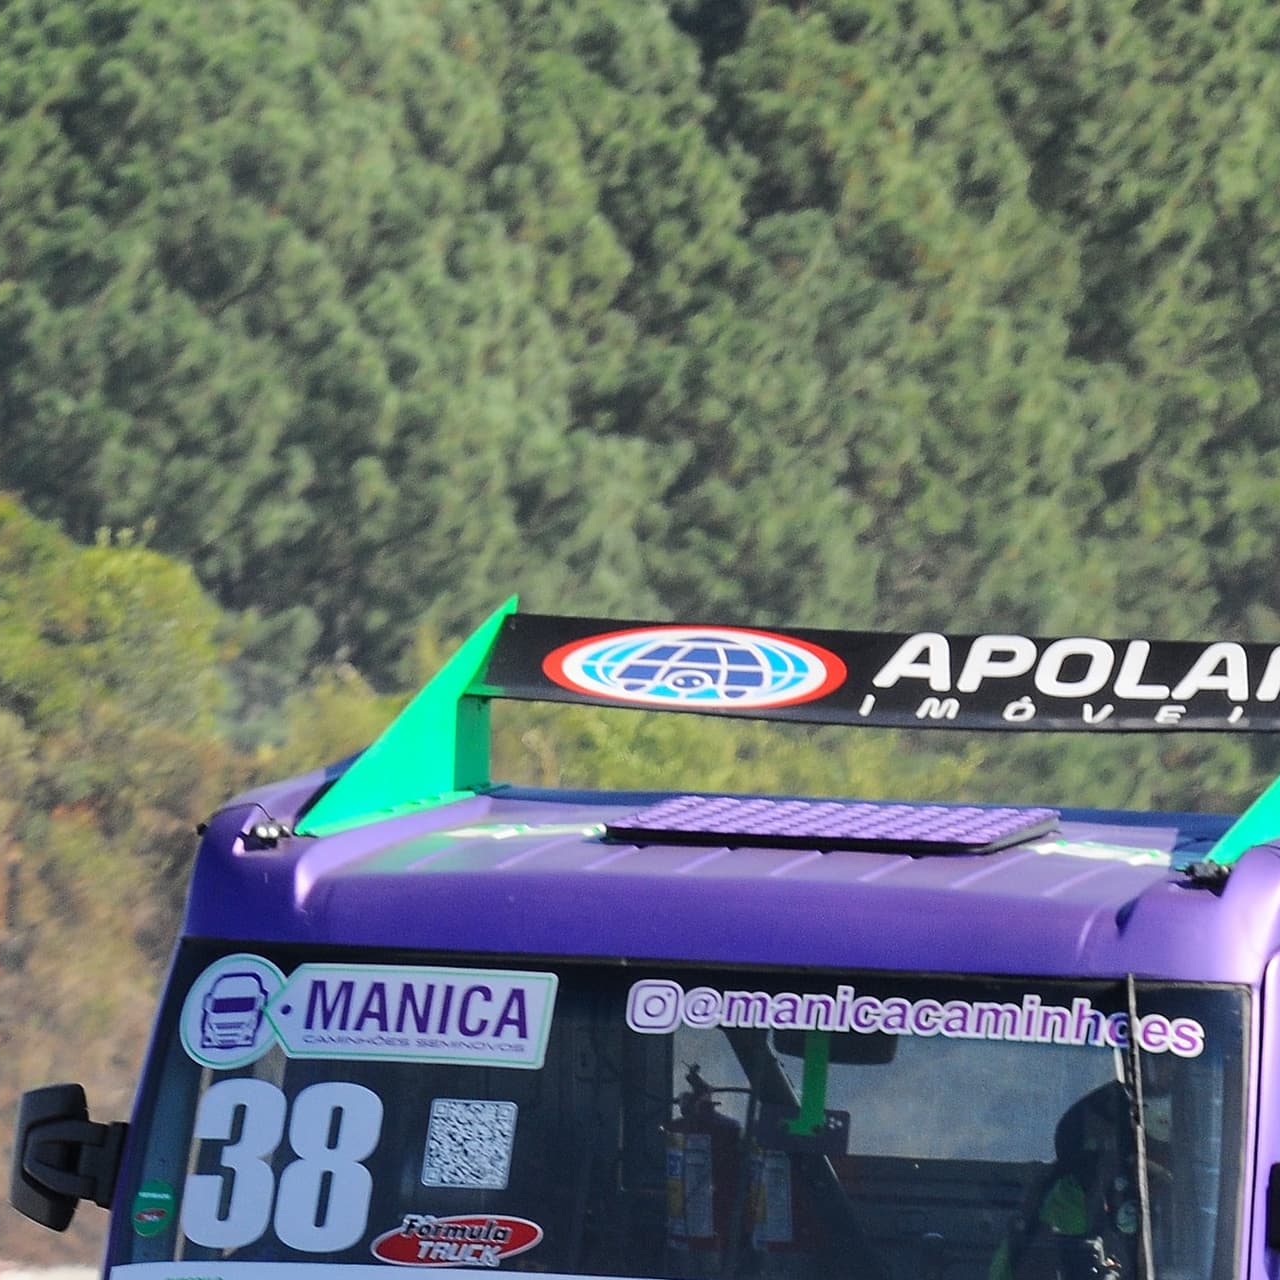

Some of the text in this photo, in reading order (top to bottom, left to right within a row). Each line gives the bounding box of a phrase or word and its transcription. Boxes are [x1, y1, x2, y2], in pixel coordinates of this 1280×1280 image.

[304, 979, 529, 1039] MANICA
[180, 1078, 385, 1254] 38
[417, 1240, 503, 1268] TRUCK
